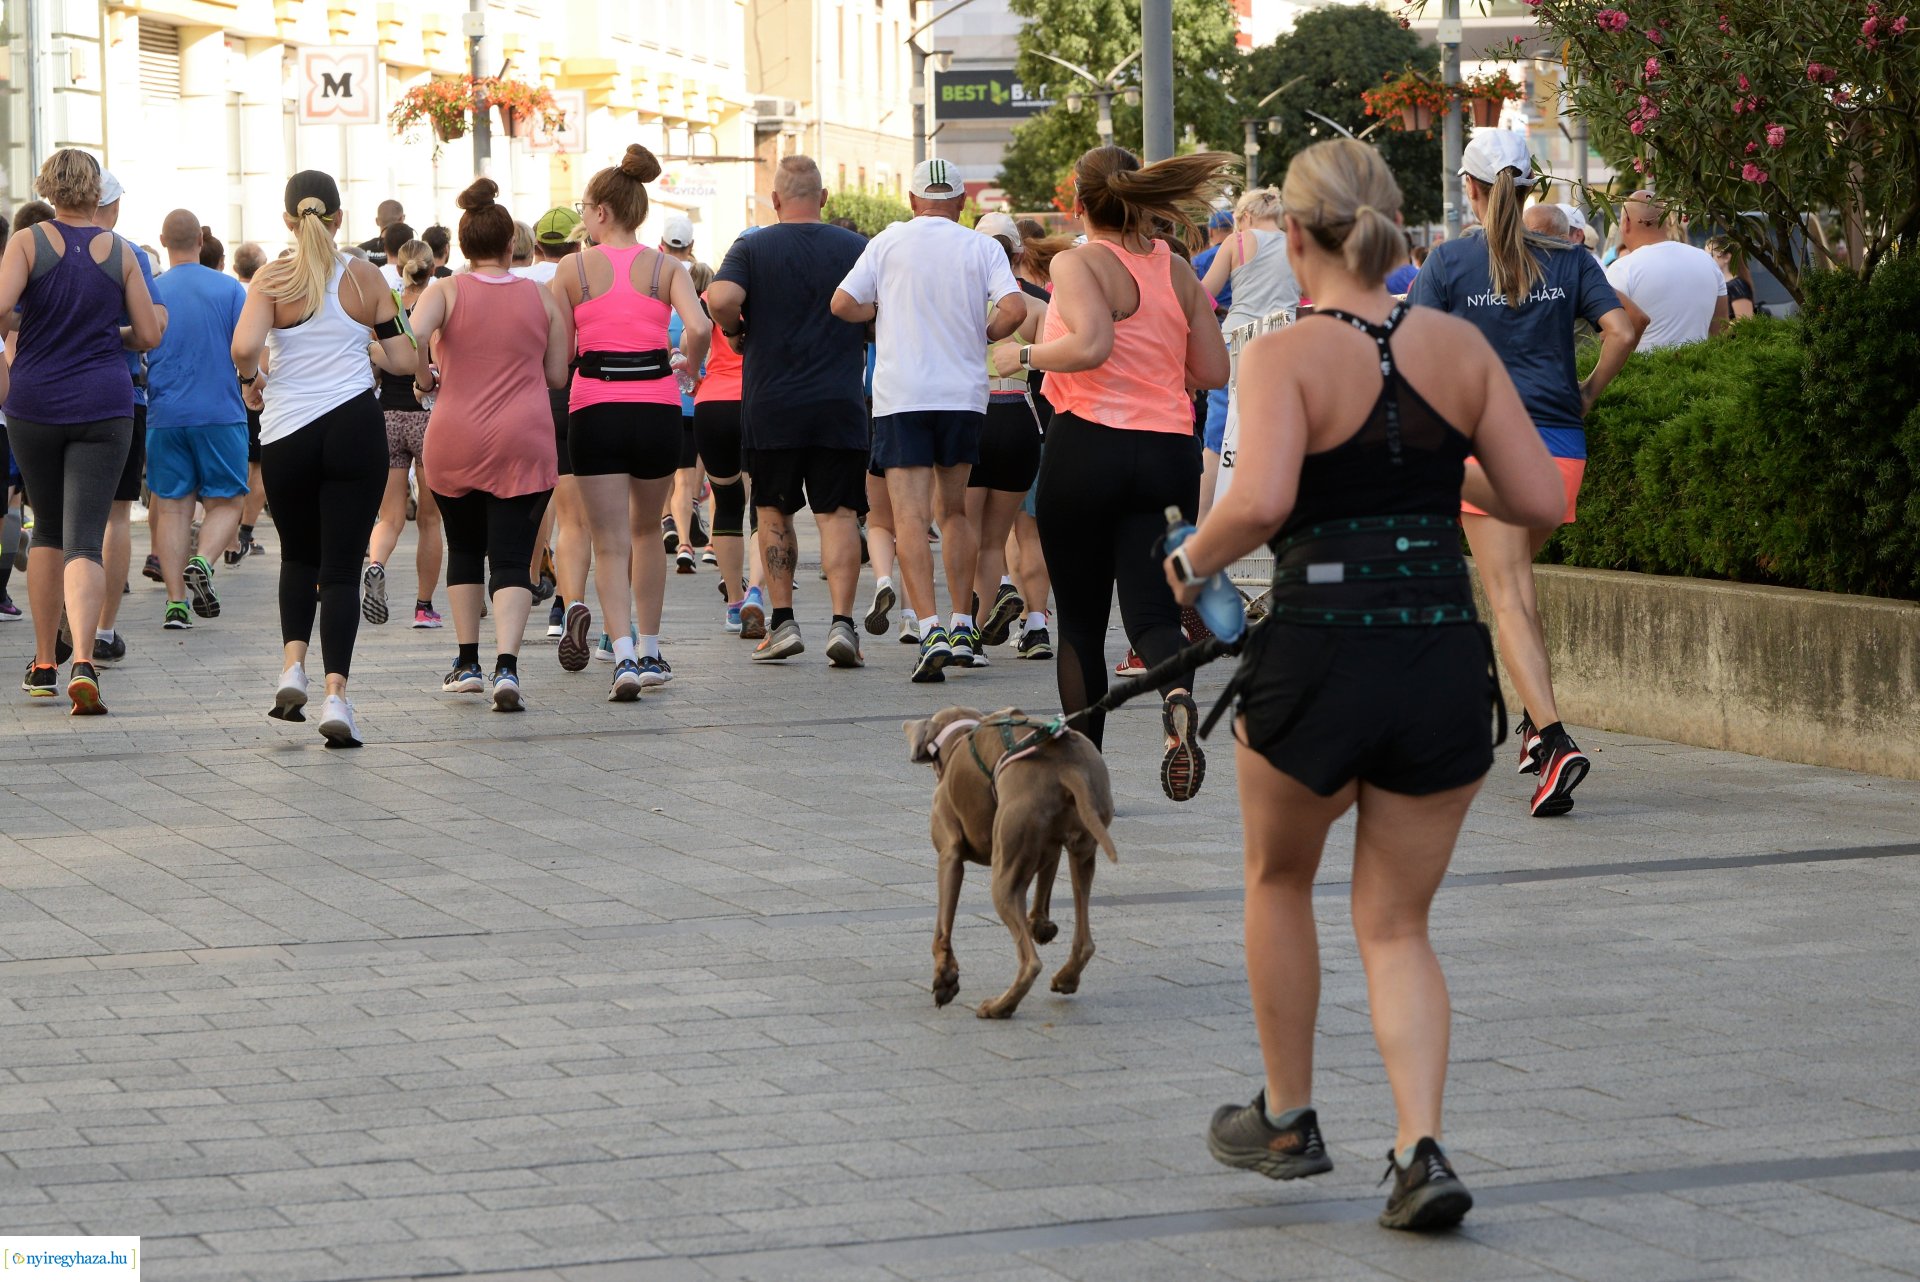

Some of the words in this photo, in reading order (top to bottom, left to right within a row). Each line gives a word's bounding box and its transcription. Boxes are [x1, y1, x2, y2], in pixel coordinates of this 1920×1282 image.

[321, 72, 353, 98] M
[942, 85, 987, 101] BEST
[1467, 284, 1566, 307] NYÍREHÁZA
